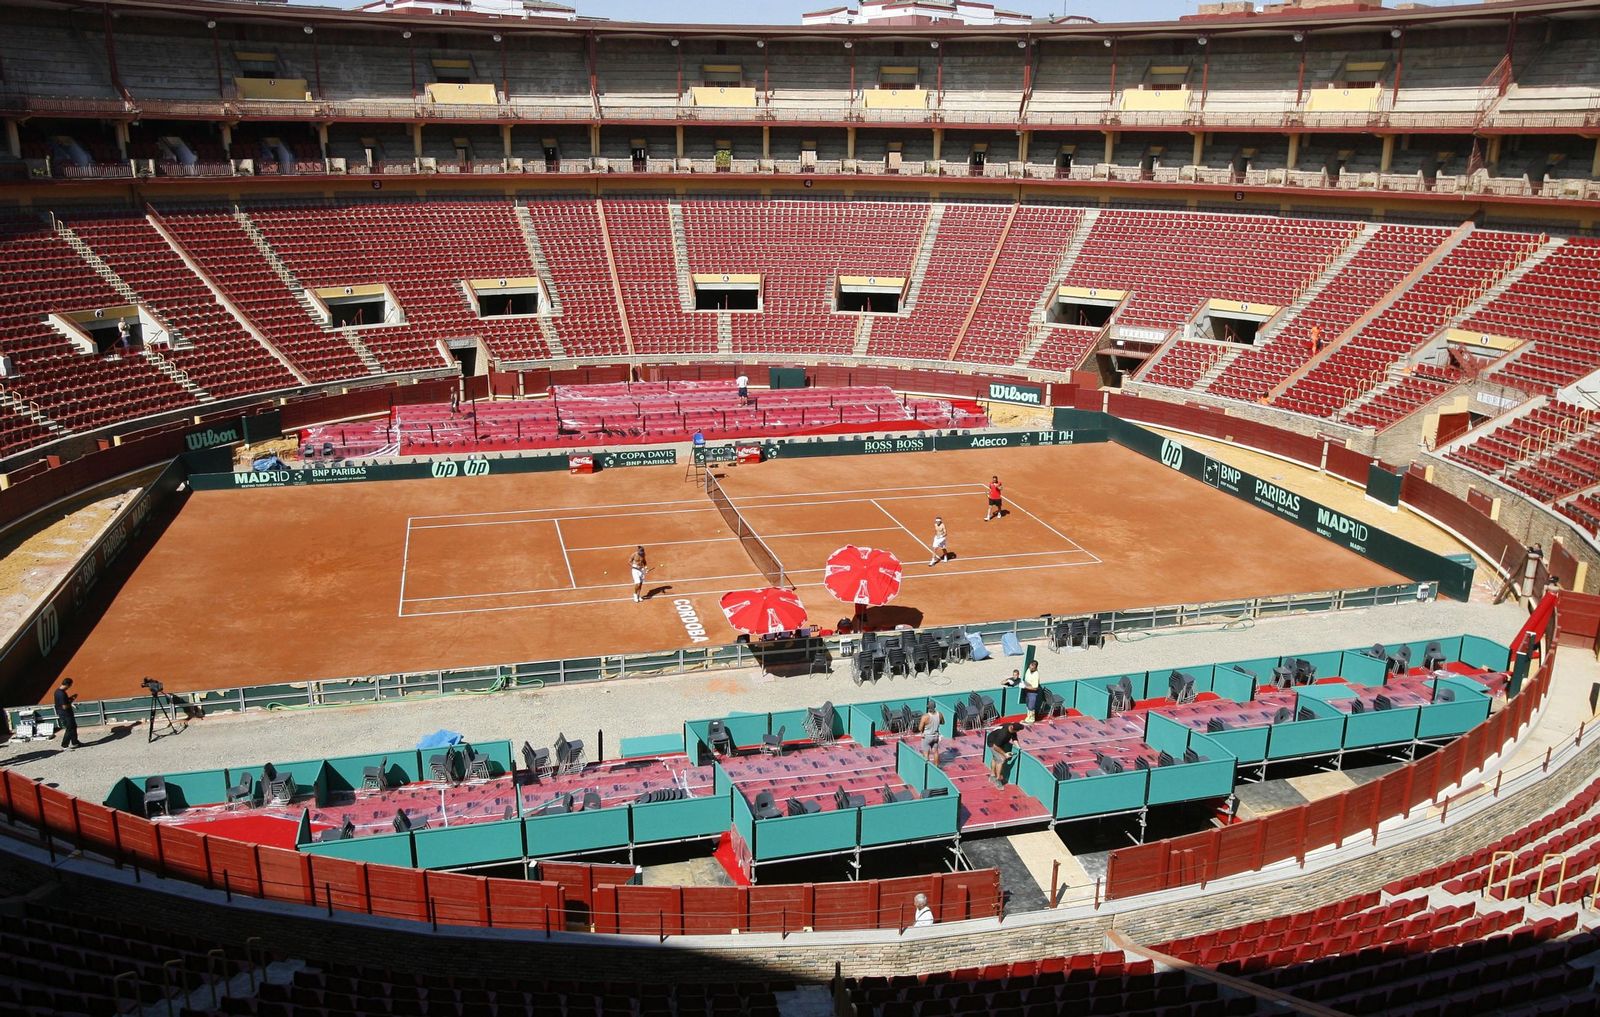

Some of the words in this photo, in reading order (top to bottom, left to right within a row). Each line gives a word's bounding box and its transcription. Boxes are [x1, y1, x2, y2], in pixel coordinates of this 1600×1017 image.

[185, 429, 239, 450] Wilson
[865, 441, 892, 450] BOSS
[896, 439, 924, 449] BOSS
[971, 437, 1008, 447] Adecco
[620, 452, 646, 460] COPA
[648, 450, 675, 458] DAVIS
[1162, 439, 1182, 468] hp
[234, 470, 290, 484] MADRID
[312, 469, 330, 477] BNP
[331, 467, 367, 476] PARIBAS
[434, 461, 456, 477] hp
[466, 459, 488, 475] hp
[1221, 464, 1242, 484] BNP
[1255, 479, 1301, 512] PARIBAS
[1317, 508, 1368, 541] MADRID
[83, 556, 97, 585] BNP
[103, 521, 128, 561] PARIBAS
